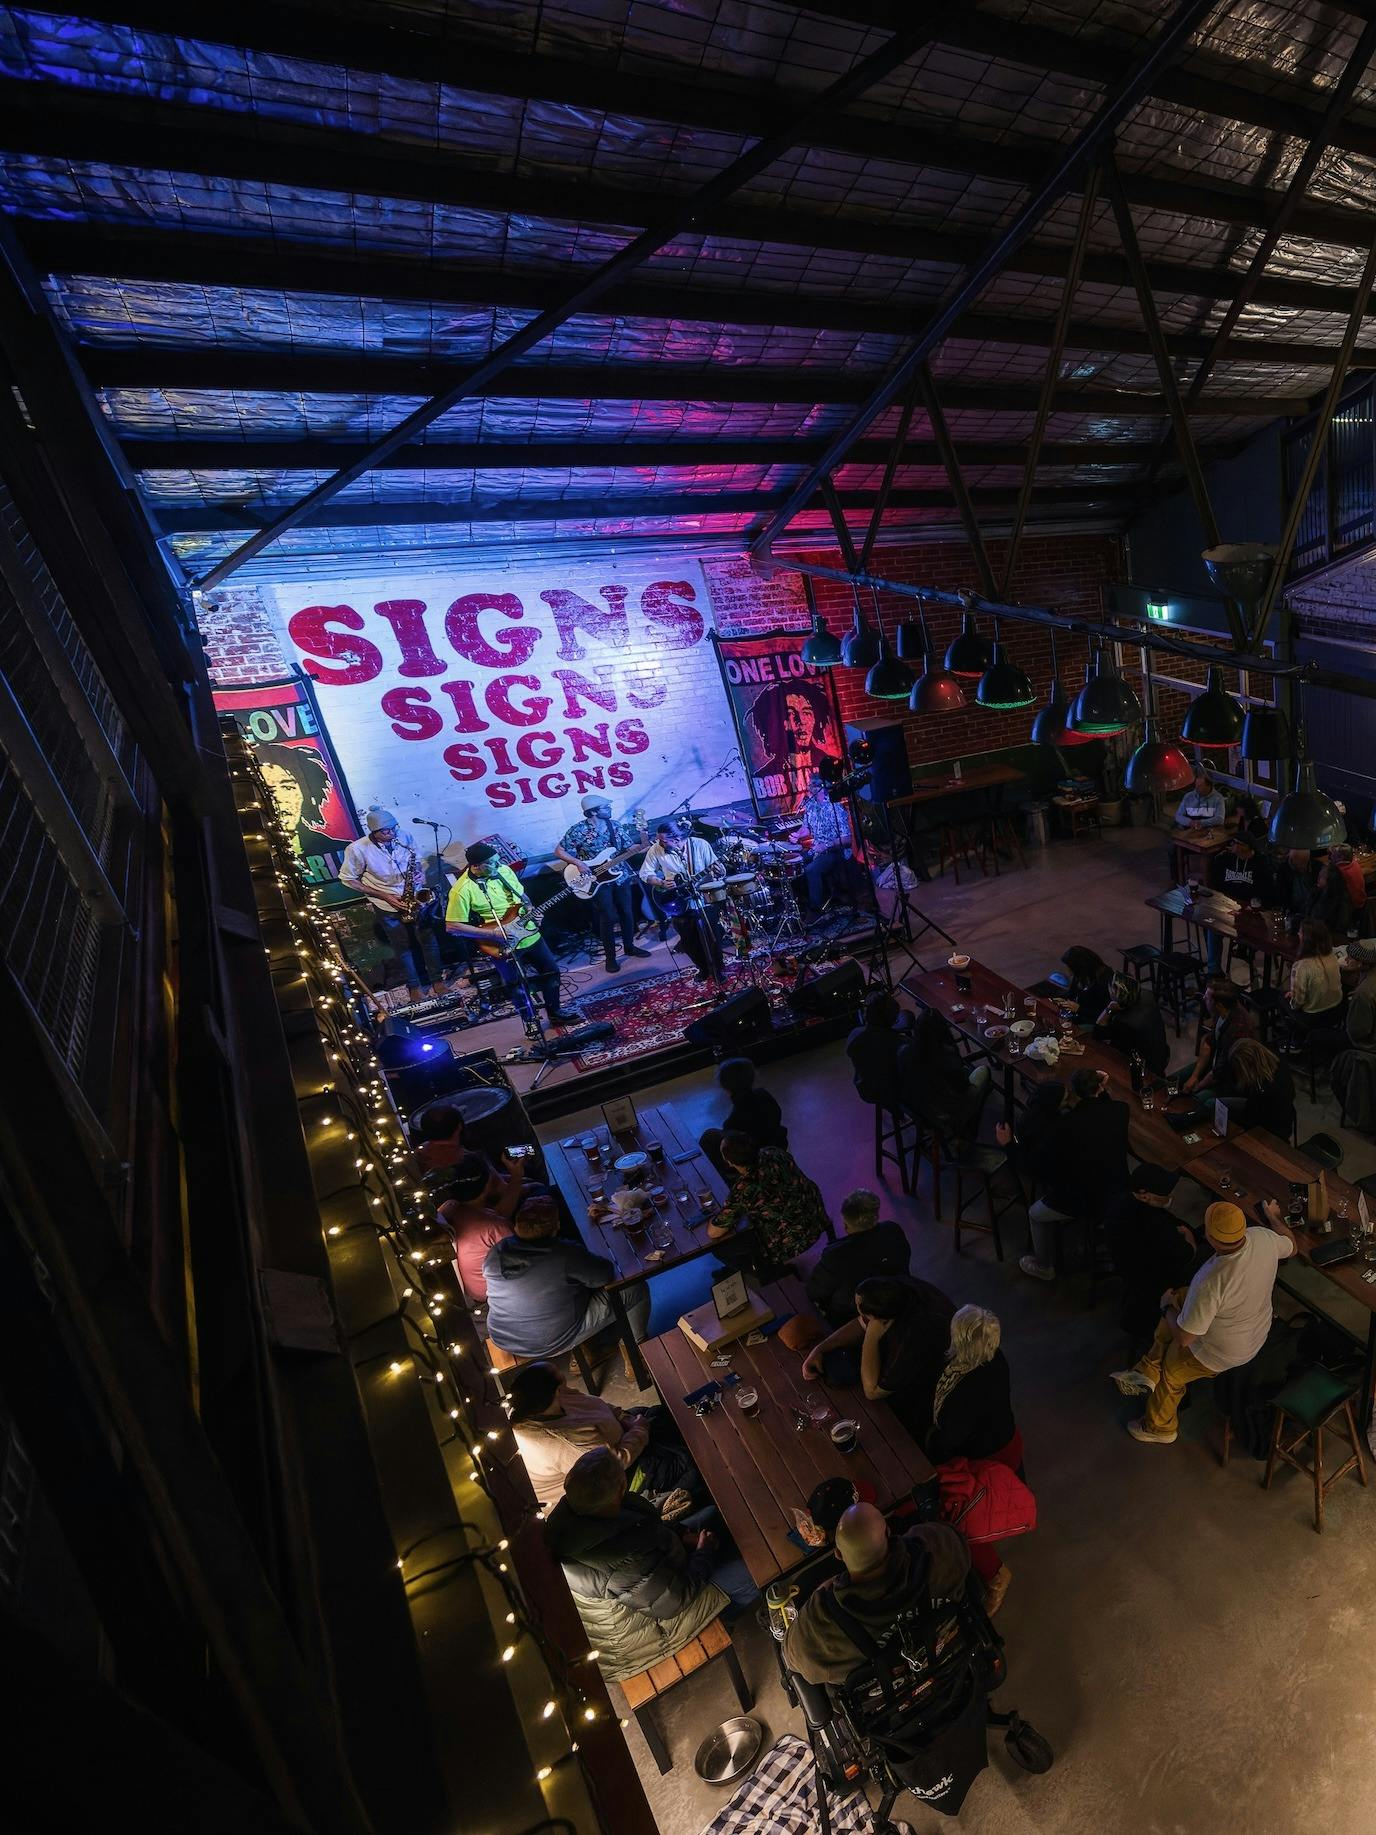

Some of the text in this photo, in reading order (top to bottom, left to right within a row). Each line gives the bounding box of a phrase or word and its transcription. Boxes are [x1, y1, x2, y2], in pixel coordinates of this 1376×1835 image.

[288, 580, 705, 686] SIGNS
[726, 657, 776, 685] ONE
[381, 664, 668, 741] SIGNS
[443, 718, 650, 782] SIGNS
[485, 761, 634, 808] SIGNS
[751, 773, 788, 799] BOB
